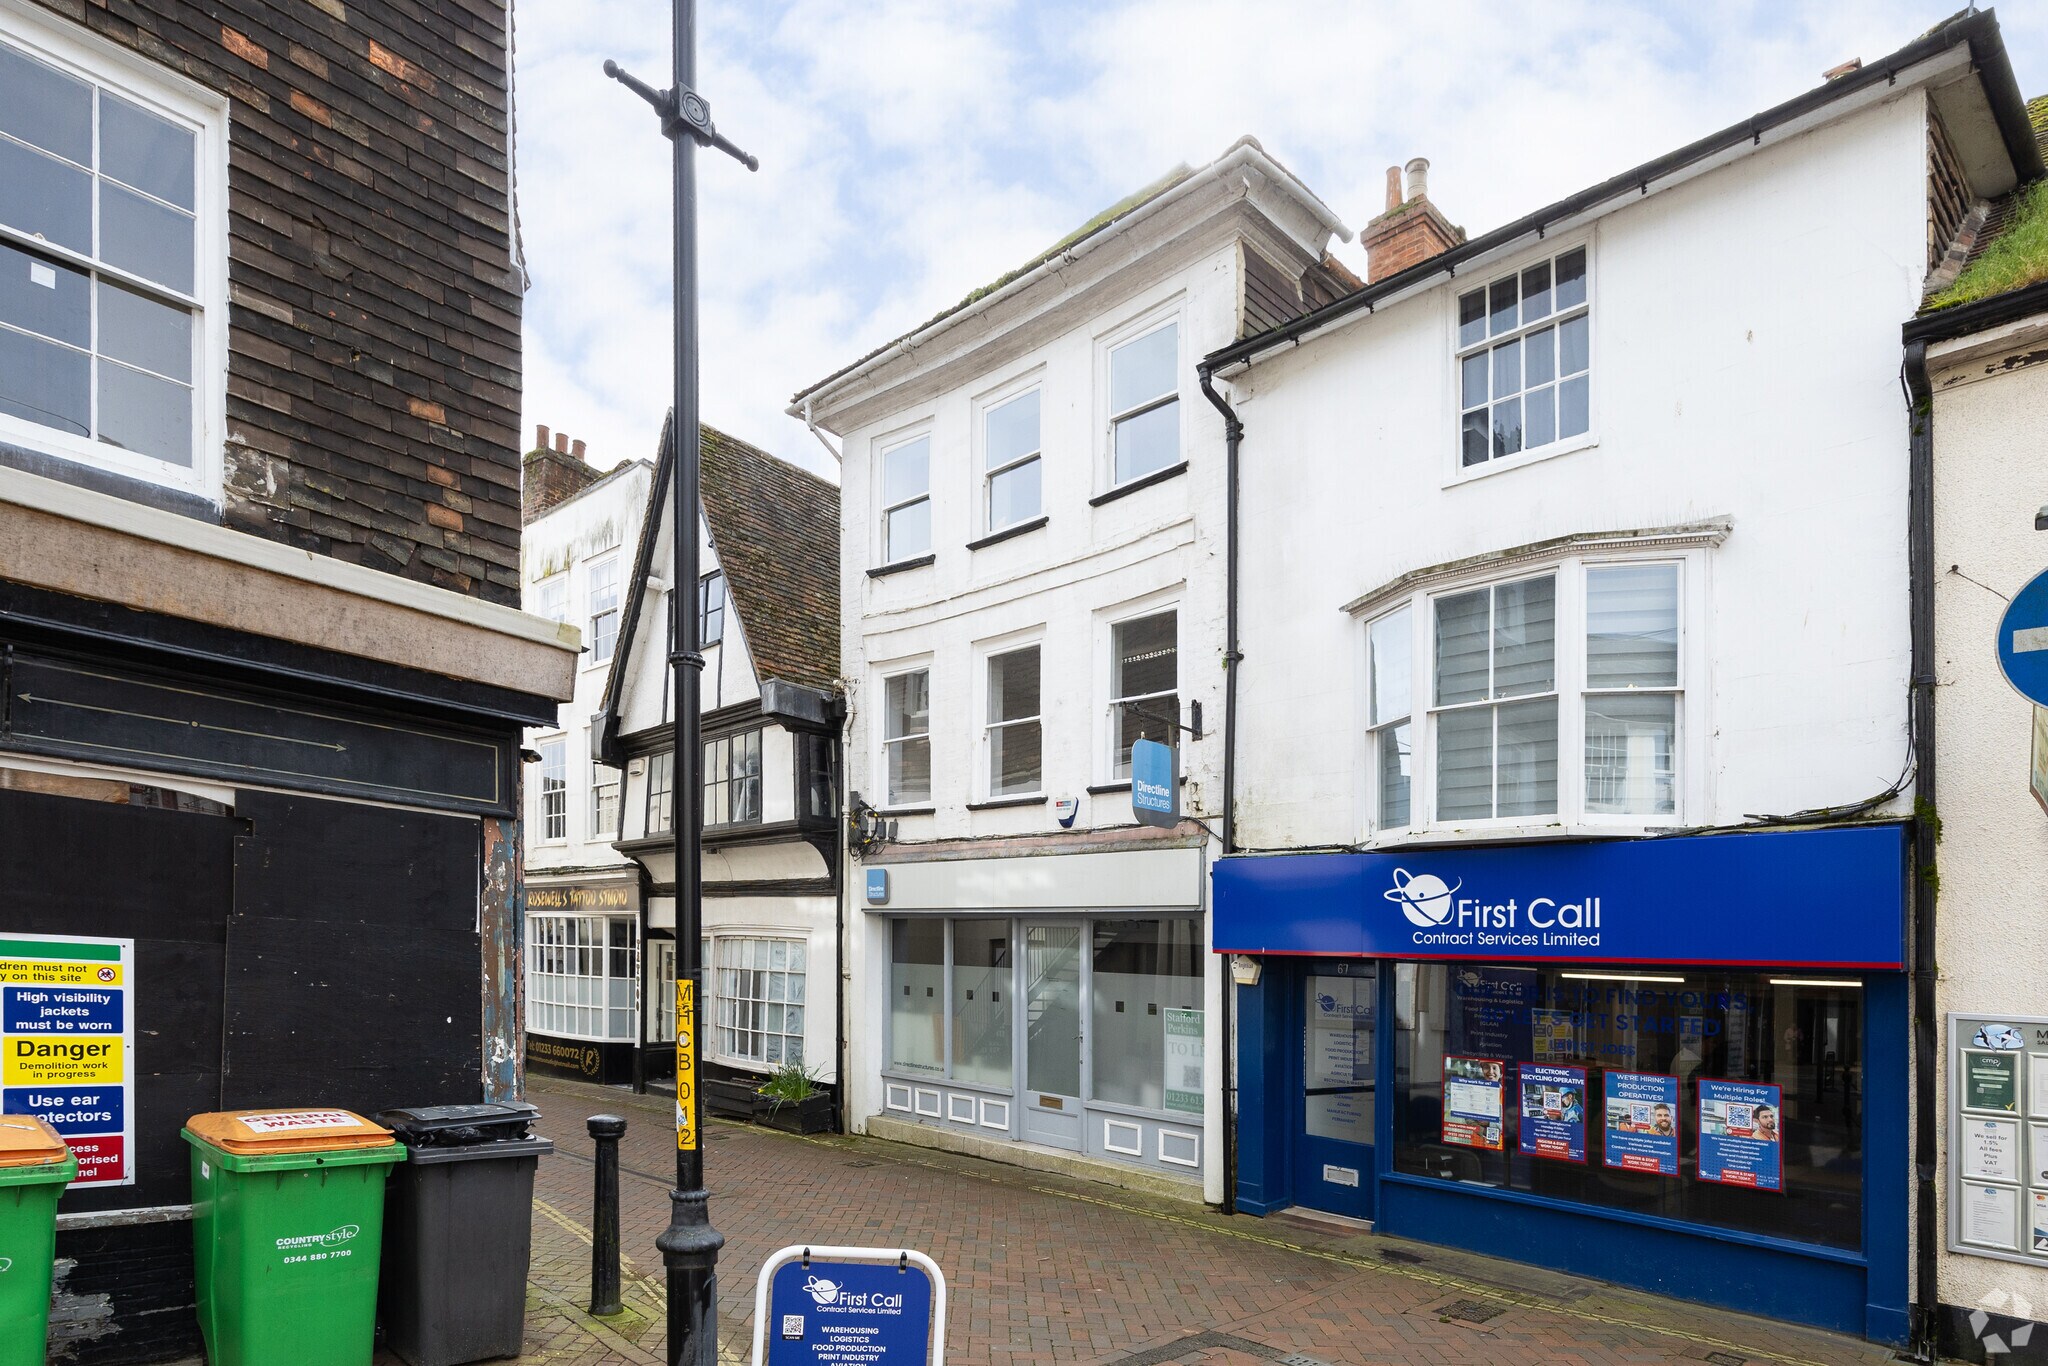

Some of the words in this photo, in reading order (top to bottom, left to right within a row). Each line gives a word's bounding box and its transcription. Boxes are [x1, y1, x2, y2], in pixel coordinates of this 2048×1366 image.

[1138, 780, 1169, 797] Directline
[1137, 792, 1170, 810] Structures
[569, 888, 596, 907] TATTOO
[599, 888, 628, 907] STUDIO
[1458, 898, 1517, 928] First
[1527, 897, 1600, 928] Call
[1412, 931, 1474, 945] Contract
[1477, 931, 1539, 946] Services
[1543, 932, 1600, 947] Limited
[33, 963, 63, 972] must
[67, 965, 87, 973] not
[1337, 963, 1349, 974] 67
[33, 972, 55, 981] this
[60, 974, 82, 982] site
[16, 991, 49, 1004] High
[53, 993, 111, 1005] visibility
[1457, 994, 1493, 1004] Warehousing
[1499, 998, 1524, 1006] Logistics
[1573, 985, 1602, 1004] TO
[1605, 987, 1658, 1007] FIND
[40, 1006, 90, 1018] jackets
[1337, 1004, 1353, 1014] First
[1166, 1012, 1200, 1024] Stafford
[16, 1020, 51, 1030] must
[56, 1020, 73, 1030] be
[78, 1021, 112, 1030] worn
[1168, 1023, 1198, 1035] Perkins
[1568, 1010, 1608, 1030] GET
[1615, 1012, 1722, 1038] STARTED
[1485, 1031, 1508, 1039] Industry
[16, 1040, 111, 1061] Danger
[535, 1042, 551, 1055] 01233
[552, 1045, 579, 1059] 660072
[1168, 1041, 1188, 1056] TO
[1191, 1043, 1204, 1057] LE
[1599, 1042, 1637, 1057] JOBS
[19, 1062, 78, 1070] Demolition
[82, 1061, 108, 1069] work
[1981, 1057, 1999, 1065] cmp
[47, 1071, 96, 1080] progress
[1535, 1067, 1570, 1076] ELECTRONIC
[1521, 1073, 1552, 1082] RECYCLING
[1552, 1076, 1584, 1085] OPERATIVE
[1616, 1074, 1639, 1082] WE'RE
[1640, 1075, 1665, 1083] HIRING
[1617, 1083, 1665, 1092] PRODUCTION
[1732, 1085, 1755, 1095] Hiring
[28, 1094, 65, 1107] Use
[70, 1095, 100, 1106] ear
[1166, 1091, 1188, 1103] 01233
[1618, 1091, 1664, 1101] OPERATIVES!
[1713, 1093, 1743, 1102] Multiple
[1743, 1096, 1766, 1104] Roles!
[37, 1110, 111, 1123] otectors
[244, 1112, 349, 1123] GENERAL
[263, 1117, 345, 1128] WASTE
[69, 1144, 99, 1153] cess
[79, 1154, 118, 1165] orised
[284, 1255, 307, 1264] 0344
[310, 1253, 327, 1261] 880
[330, 1249, 352, 1258] 7700
[839, 1292, 868, 1306] First
[871, 1293, 902, 1308] Call
[821, 1326, 879, 1335] WAREHOUSING
[830, 1335, 870, 1343] LOGISTICS
[835, 1345, 886, 1353] PRODUCTION
[818, 1353, 840, 1361] PRINT
[841, 1354, 880, 1362] INDUSTRY
